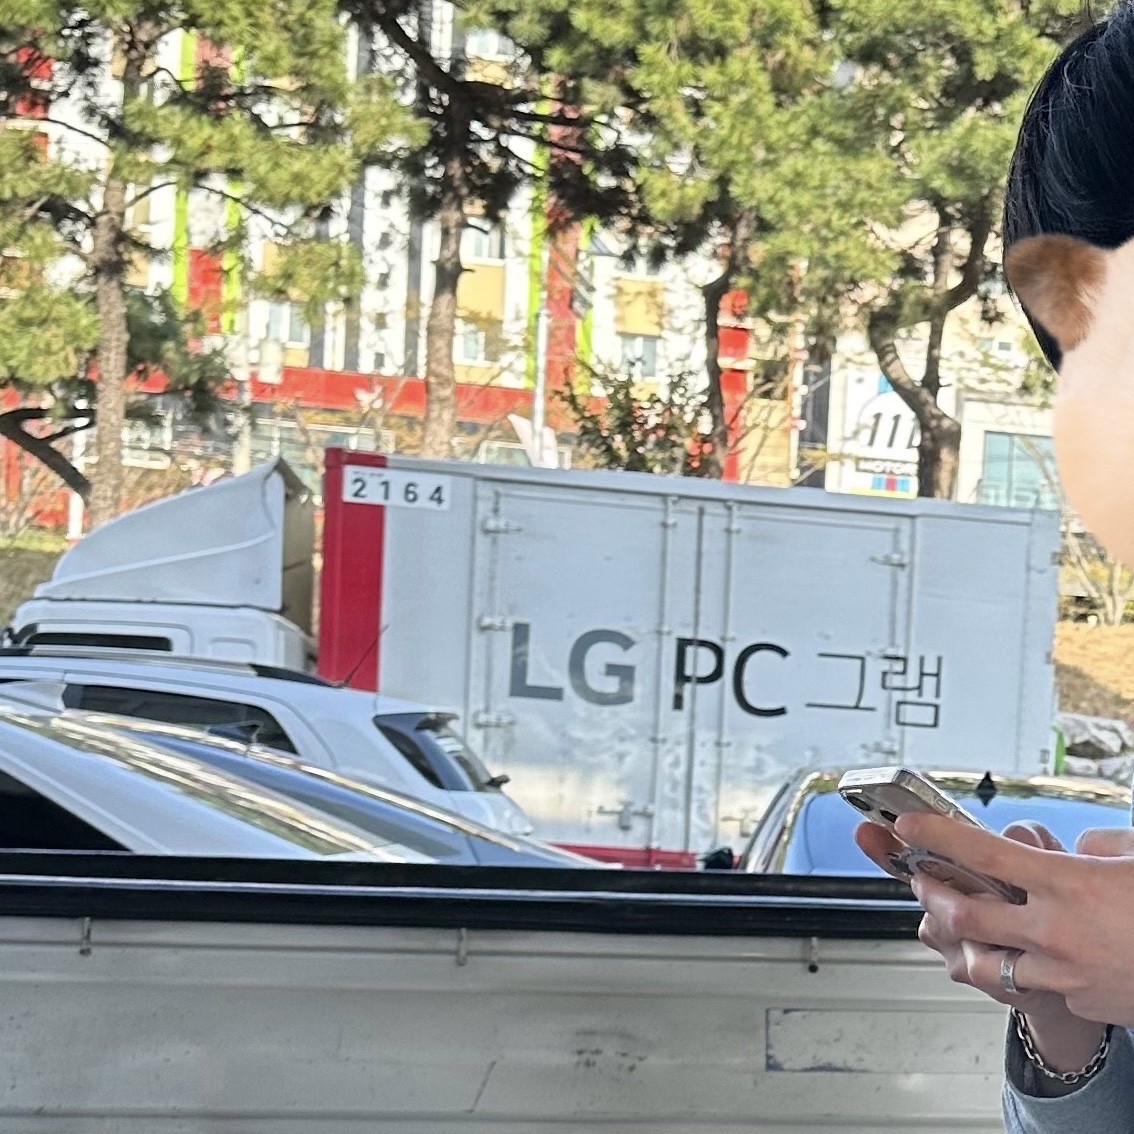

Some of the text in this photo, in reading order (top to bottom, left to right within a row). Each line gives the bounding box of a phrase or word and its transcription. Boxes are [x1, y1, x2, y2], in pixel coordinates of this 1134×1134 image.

[351, 477, 446, 505] 2164
[507, 622, 942, 728] LG PC 그램
